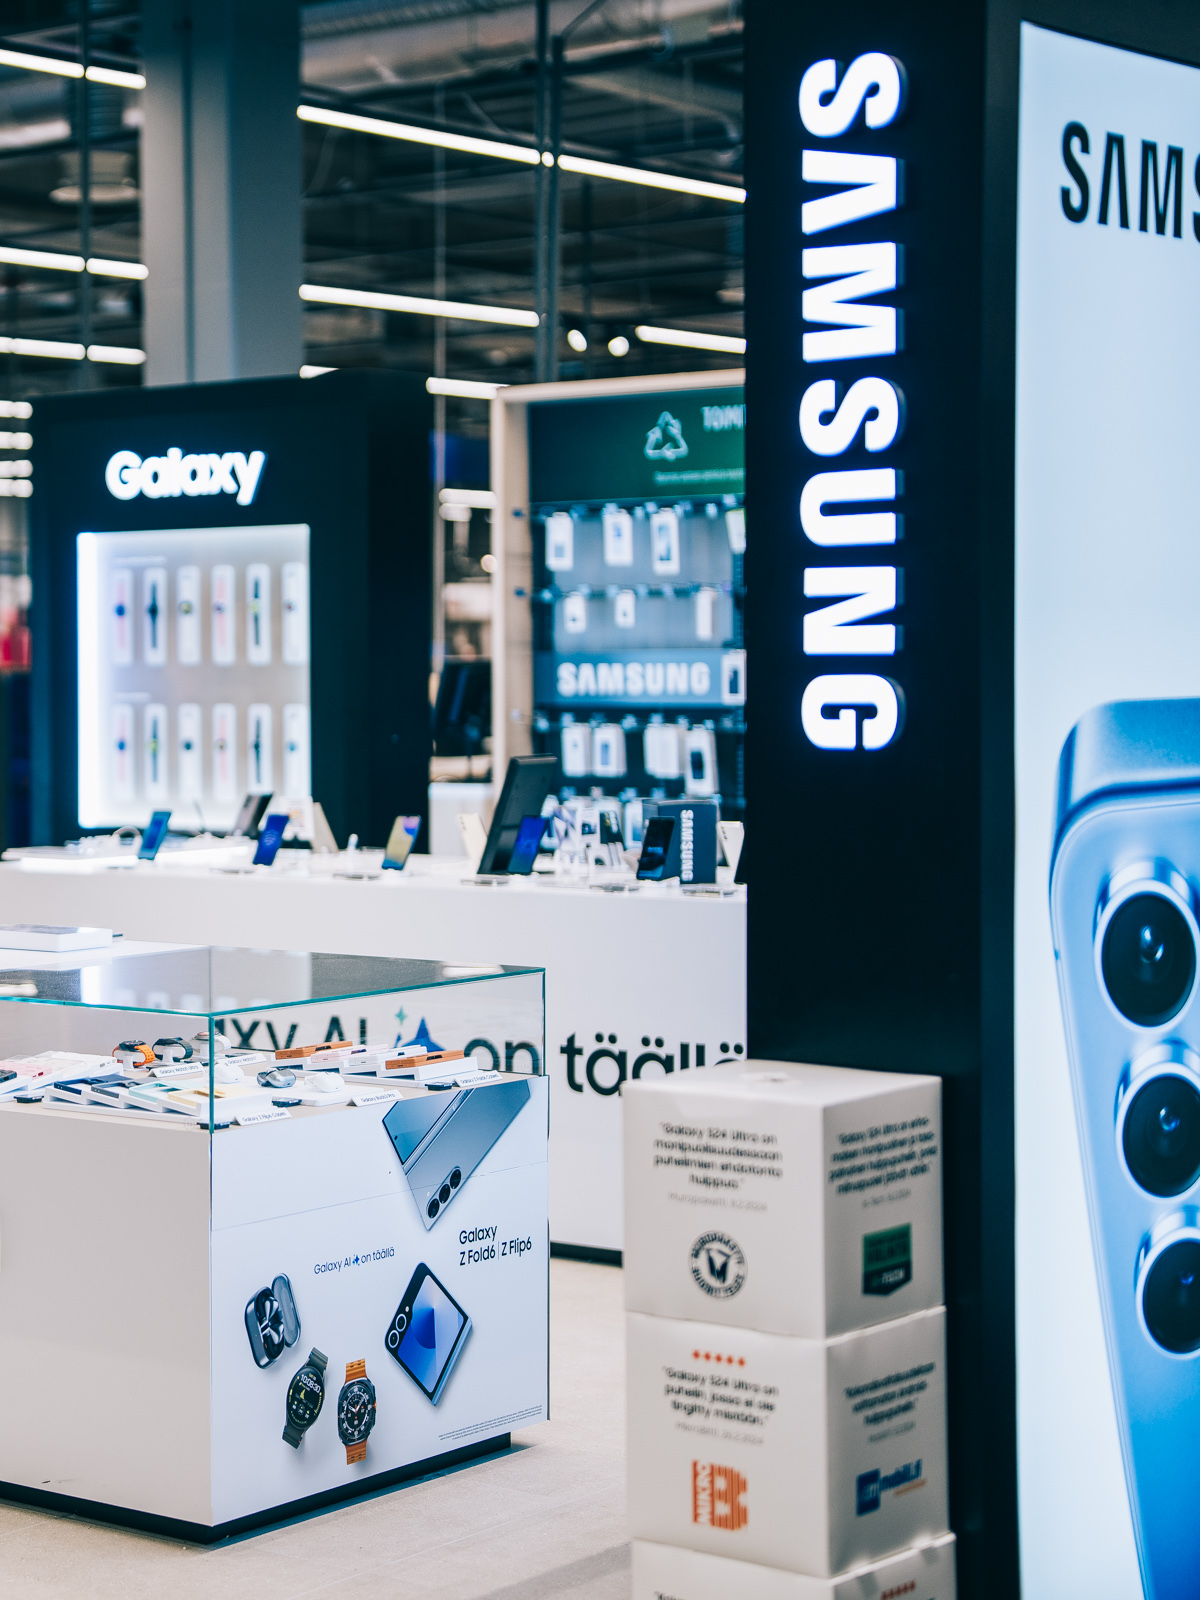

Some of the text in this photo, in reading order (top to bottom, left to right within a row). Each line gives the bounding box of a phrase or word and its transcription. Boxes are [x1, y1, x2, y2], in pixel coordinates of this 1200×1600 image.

[1060, 120, 1200, 245] SAM
[798, 51, 904, 751] SAMSUNG
[104, 446, 265, 507] Galaxy
[557, 662, 711, 696] SAMSUNG
[680, 809, 693, 882] SAMSUNG
[463, 1037, 541, 1075] on
[560, 1031, 745, 1097] tää
[313, 1246, 395, 1275] Galaxy AI on täällä
[459, 1225, 498, 1245] Galaxy
[459, 1236, 532, 1266] Z Fold6 Z Flip6
